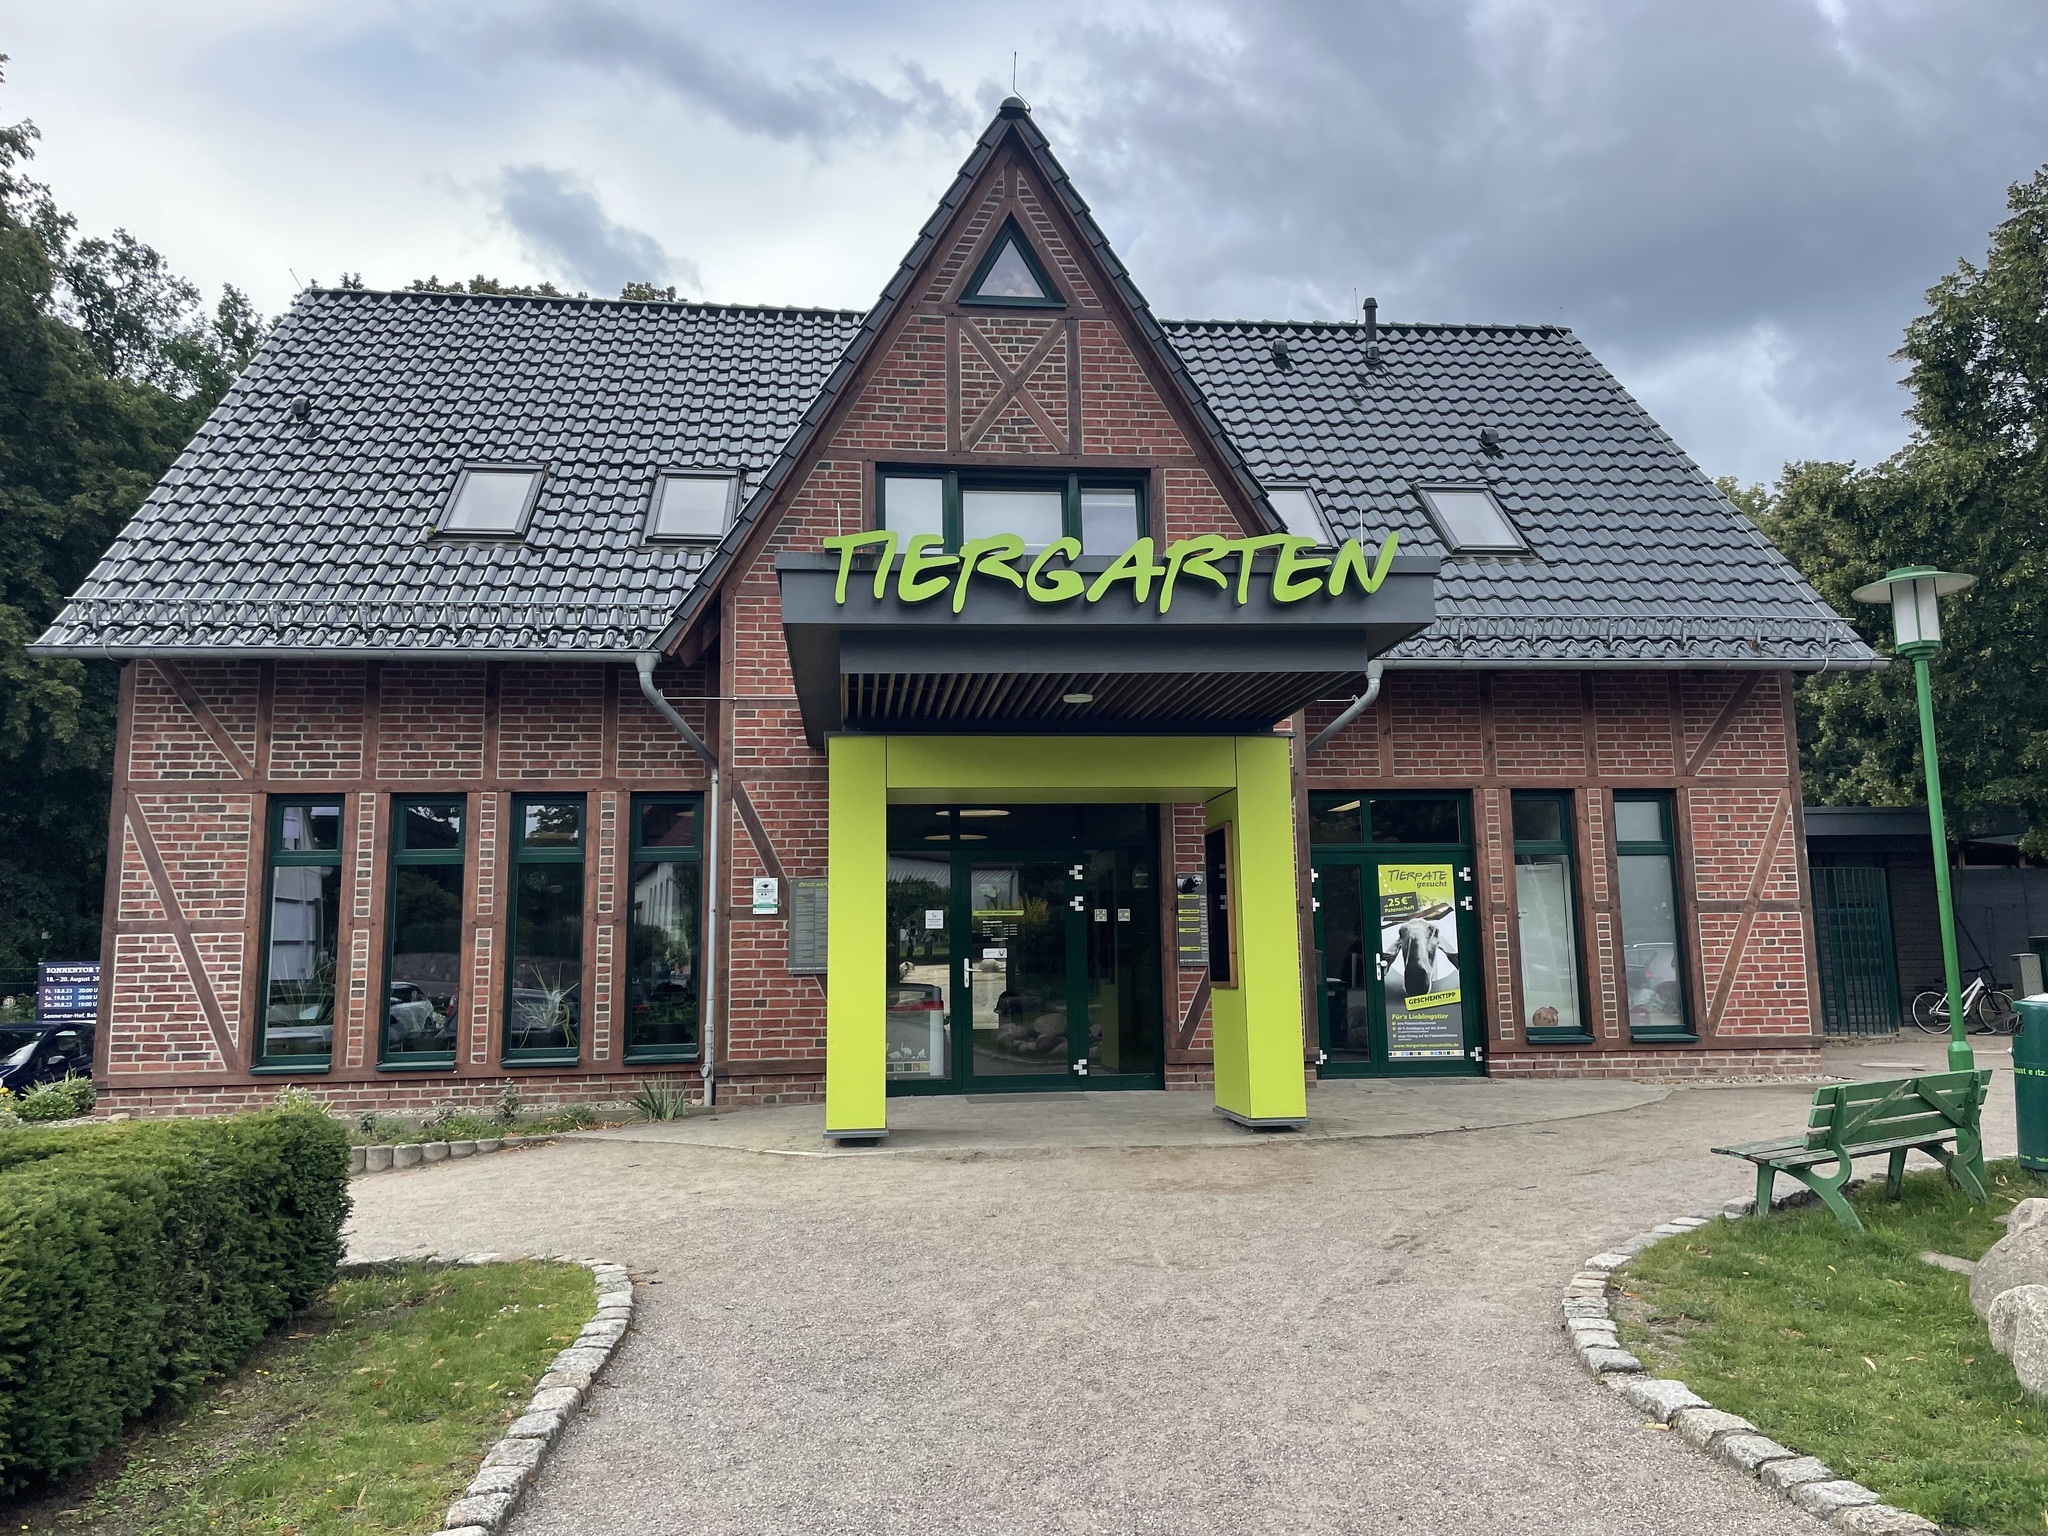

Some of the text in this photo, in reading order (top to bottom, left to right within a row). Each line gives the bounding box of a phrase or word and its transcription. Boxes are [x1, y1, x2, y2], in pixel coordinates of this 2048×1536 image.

[823, 530, 1398, 614] TIERGARTEN
[1388, 870, 1447, 882] TIERPATE
[1384, 905, 1415, 913] Patenschaft
[1408, 992, 1456, 1005] GESCHENKTIPP
